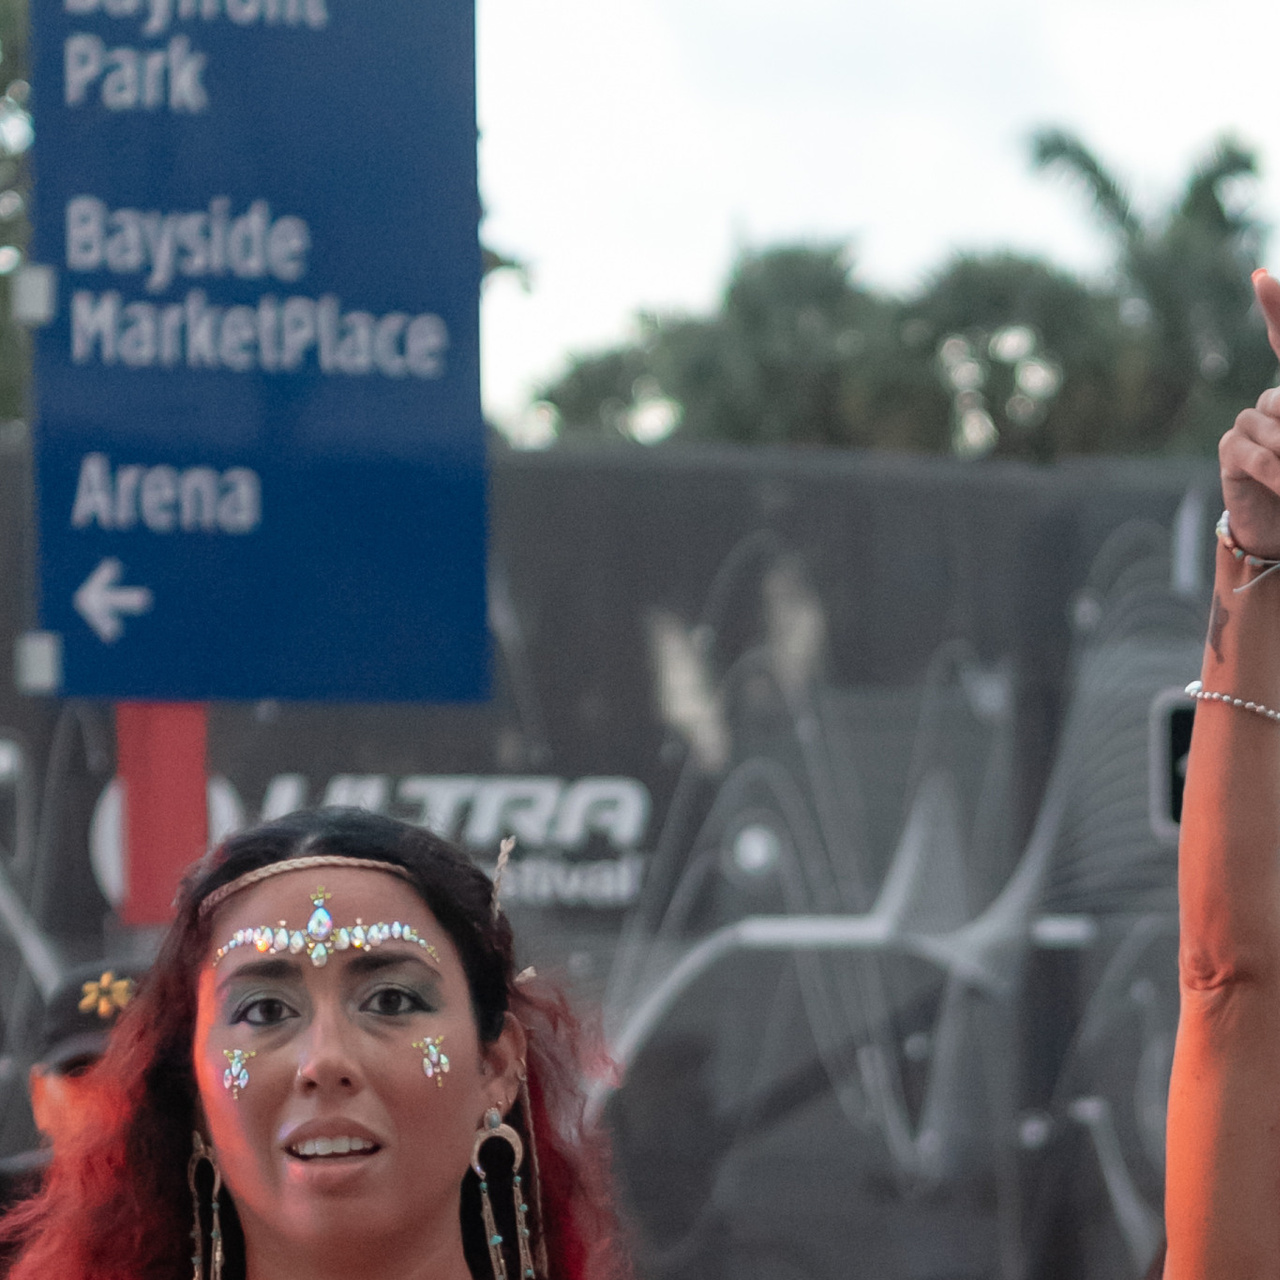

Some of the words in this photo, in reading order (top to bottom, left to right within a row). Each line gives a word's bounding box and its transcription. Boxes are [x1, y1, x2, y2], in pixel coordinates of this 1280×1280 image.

[64, 33, 208, 112] Park
[65, 197, 310, 292] Bayside
[69, 291, 448, 378] MarketPlace
[71, 452, 263, 533] Arena
